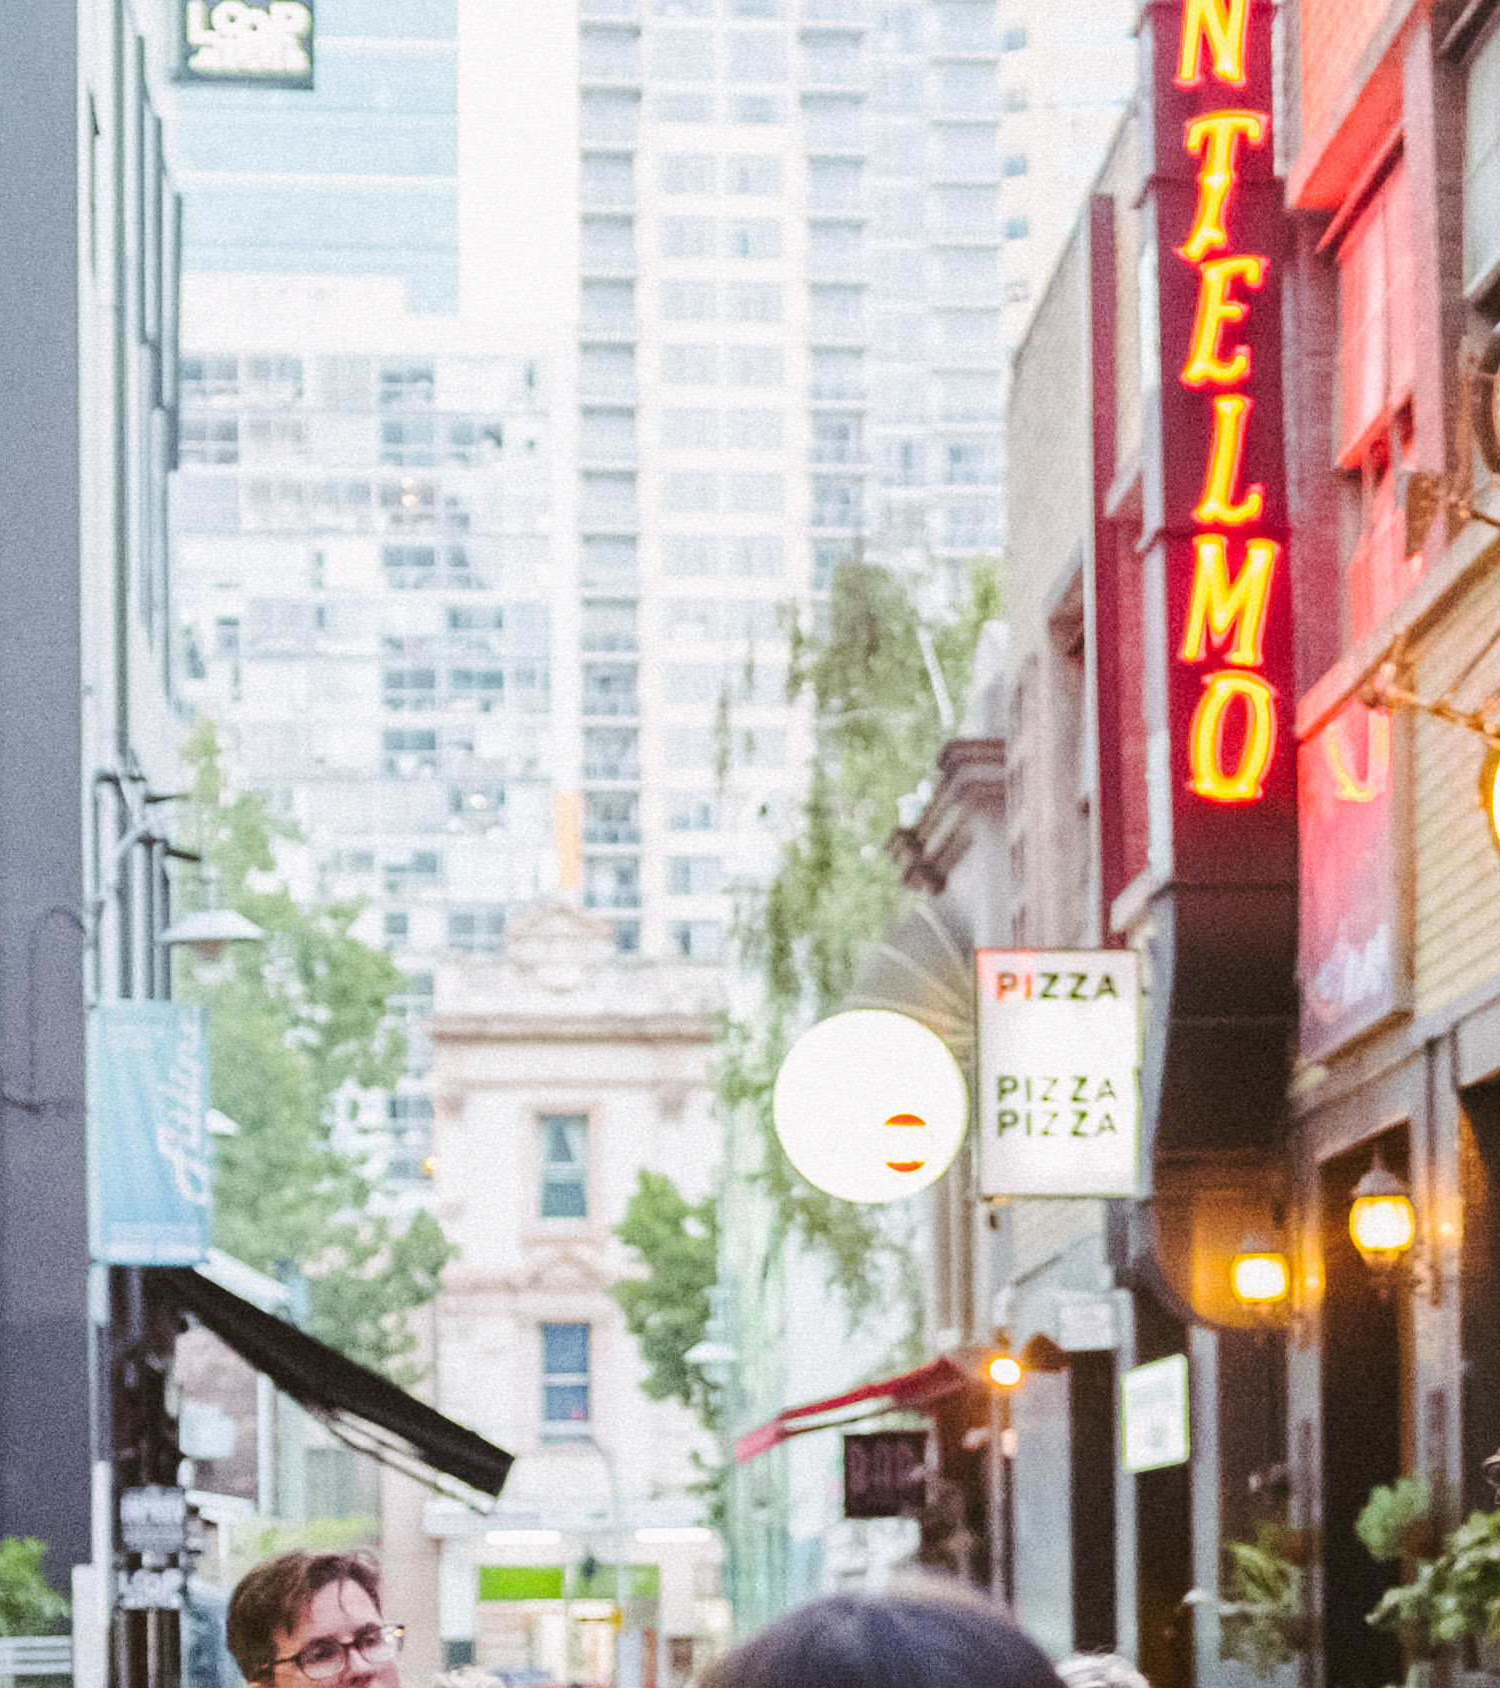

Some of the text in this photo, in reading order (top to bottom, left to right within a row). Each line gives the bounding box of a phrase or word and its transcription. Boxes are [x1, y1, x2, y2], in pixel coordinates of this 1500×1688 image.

[996, 972, 1119, 1000] PIZZA
[997, 1075, 1117, 1102] PIZZA
[997, 1109, 1118, 1137] PIZZA
